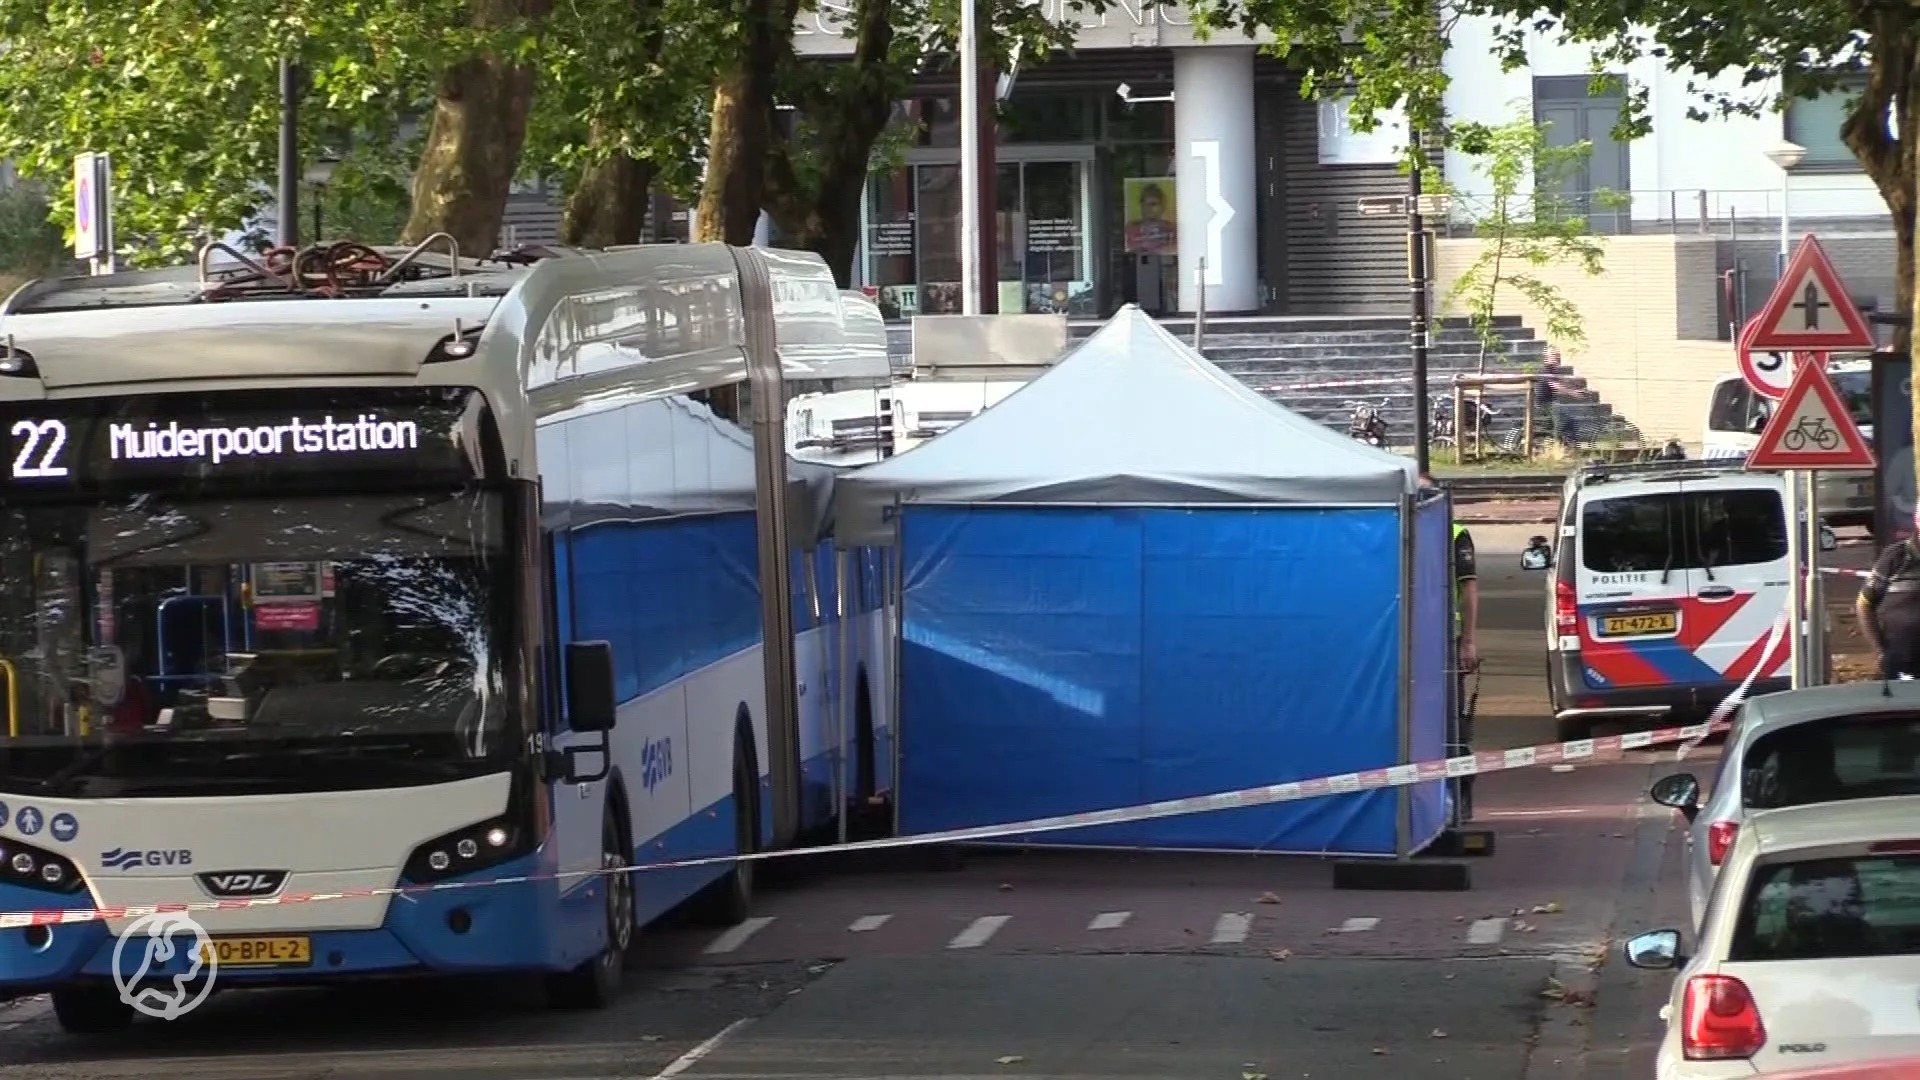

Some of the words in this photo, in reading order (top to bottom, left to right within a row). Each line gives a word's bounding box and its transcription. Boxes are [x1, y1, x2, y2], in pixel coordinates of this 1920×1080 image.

[109, 414, 418, 464] Muiderpoortstation
[11, 419, 67, 477] 22
[1592, 573, 1648, 585] POLITIE
[1610, 616, 1669, 632] ZT-472-X
[145, 849, 193, 866] GVB
[209, 873, 274, 891] VDL
[204, 940, 301, 960] 0-BPL-2
[1778, 1042, 1827, 1054] POLO
